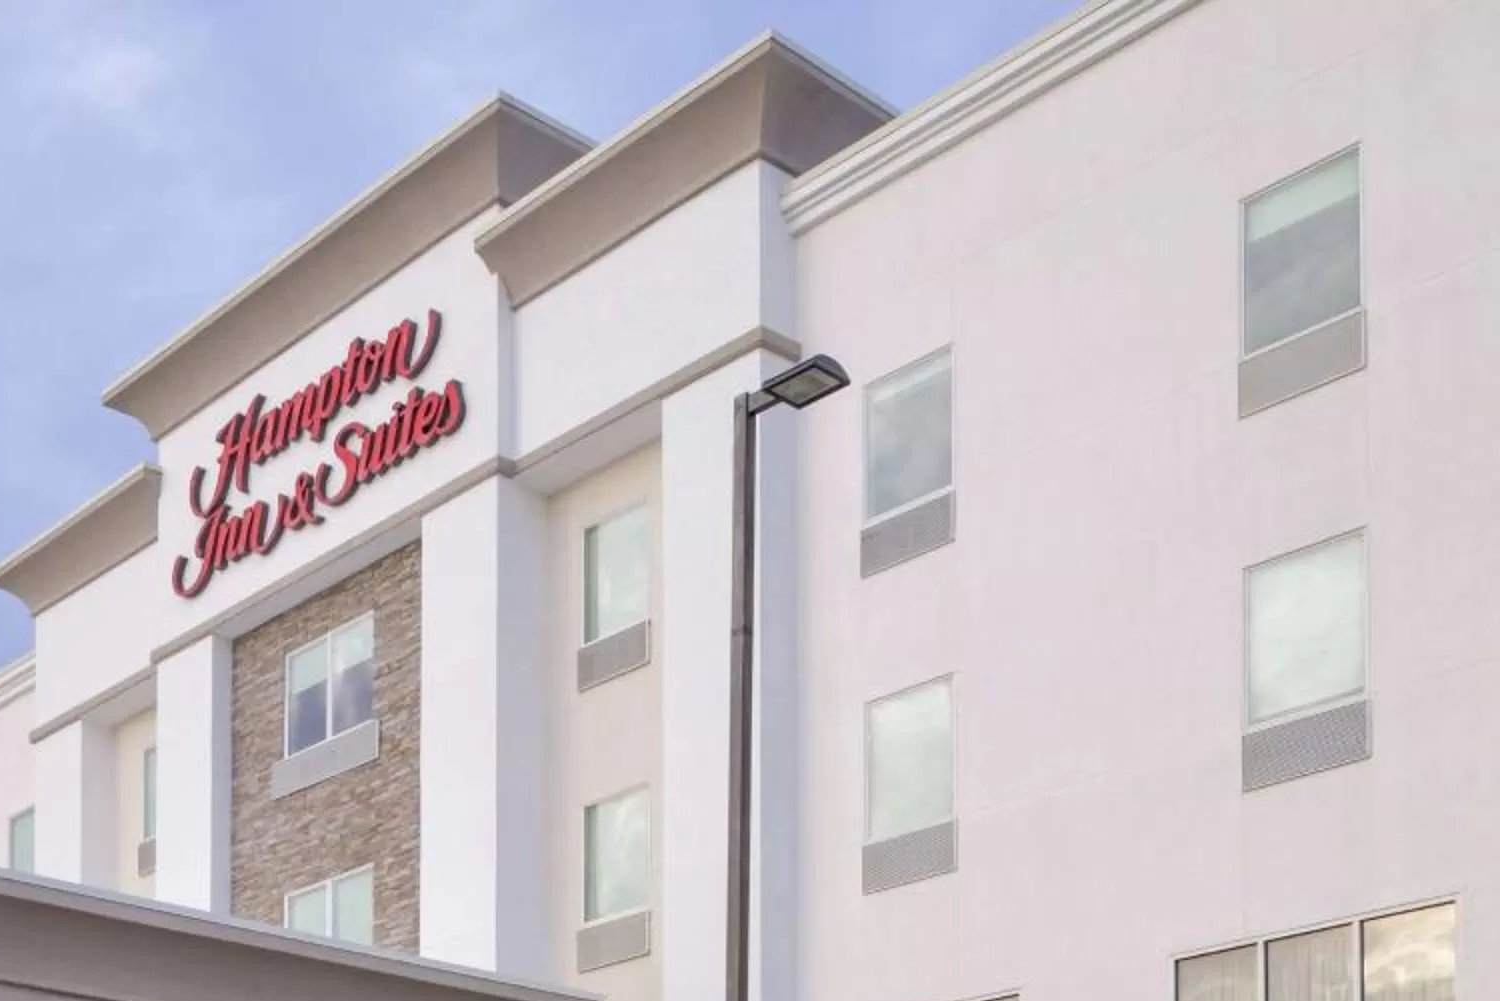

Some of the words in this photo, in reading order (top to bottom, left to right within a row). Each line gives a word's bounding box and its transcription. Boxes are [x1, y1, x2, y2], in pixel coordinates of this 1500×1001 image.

[172, 494, 286, 599] Inn
[284, 473, 325, 531] &
[315, 379, 466, 507] Suites
[190, 308, 442, 519] Hampton
